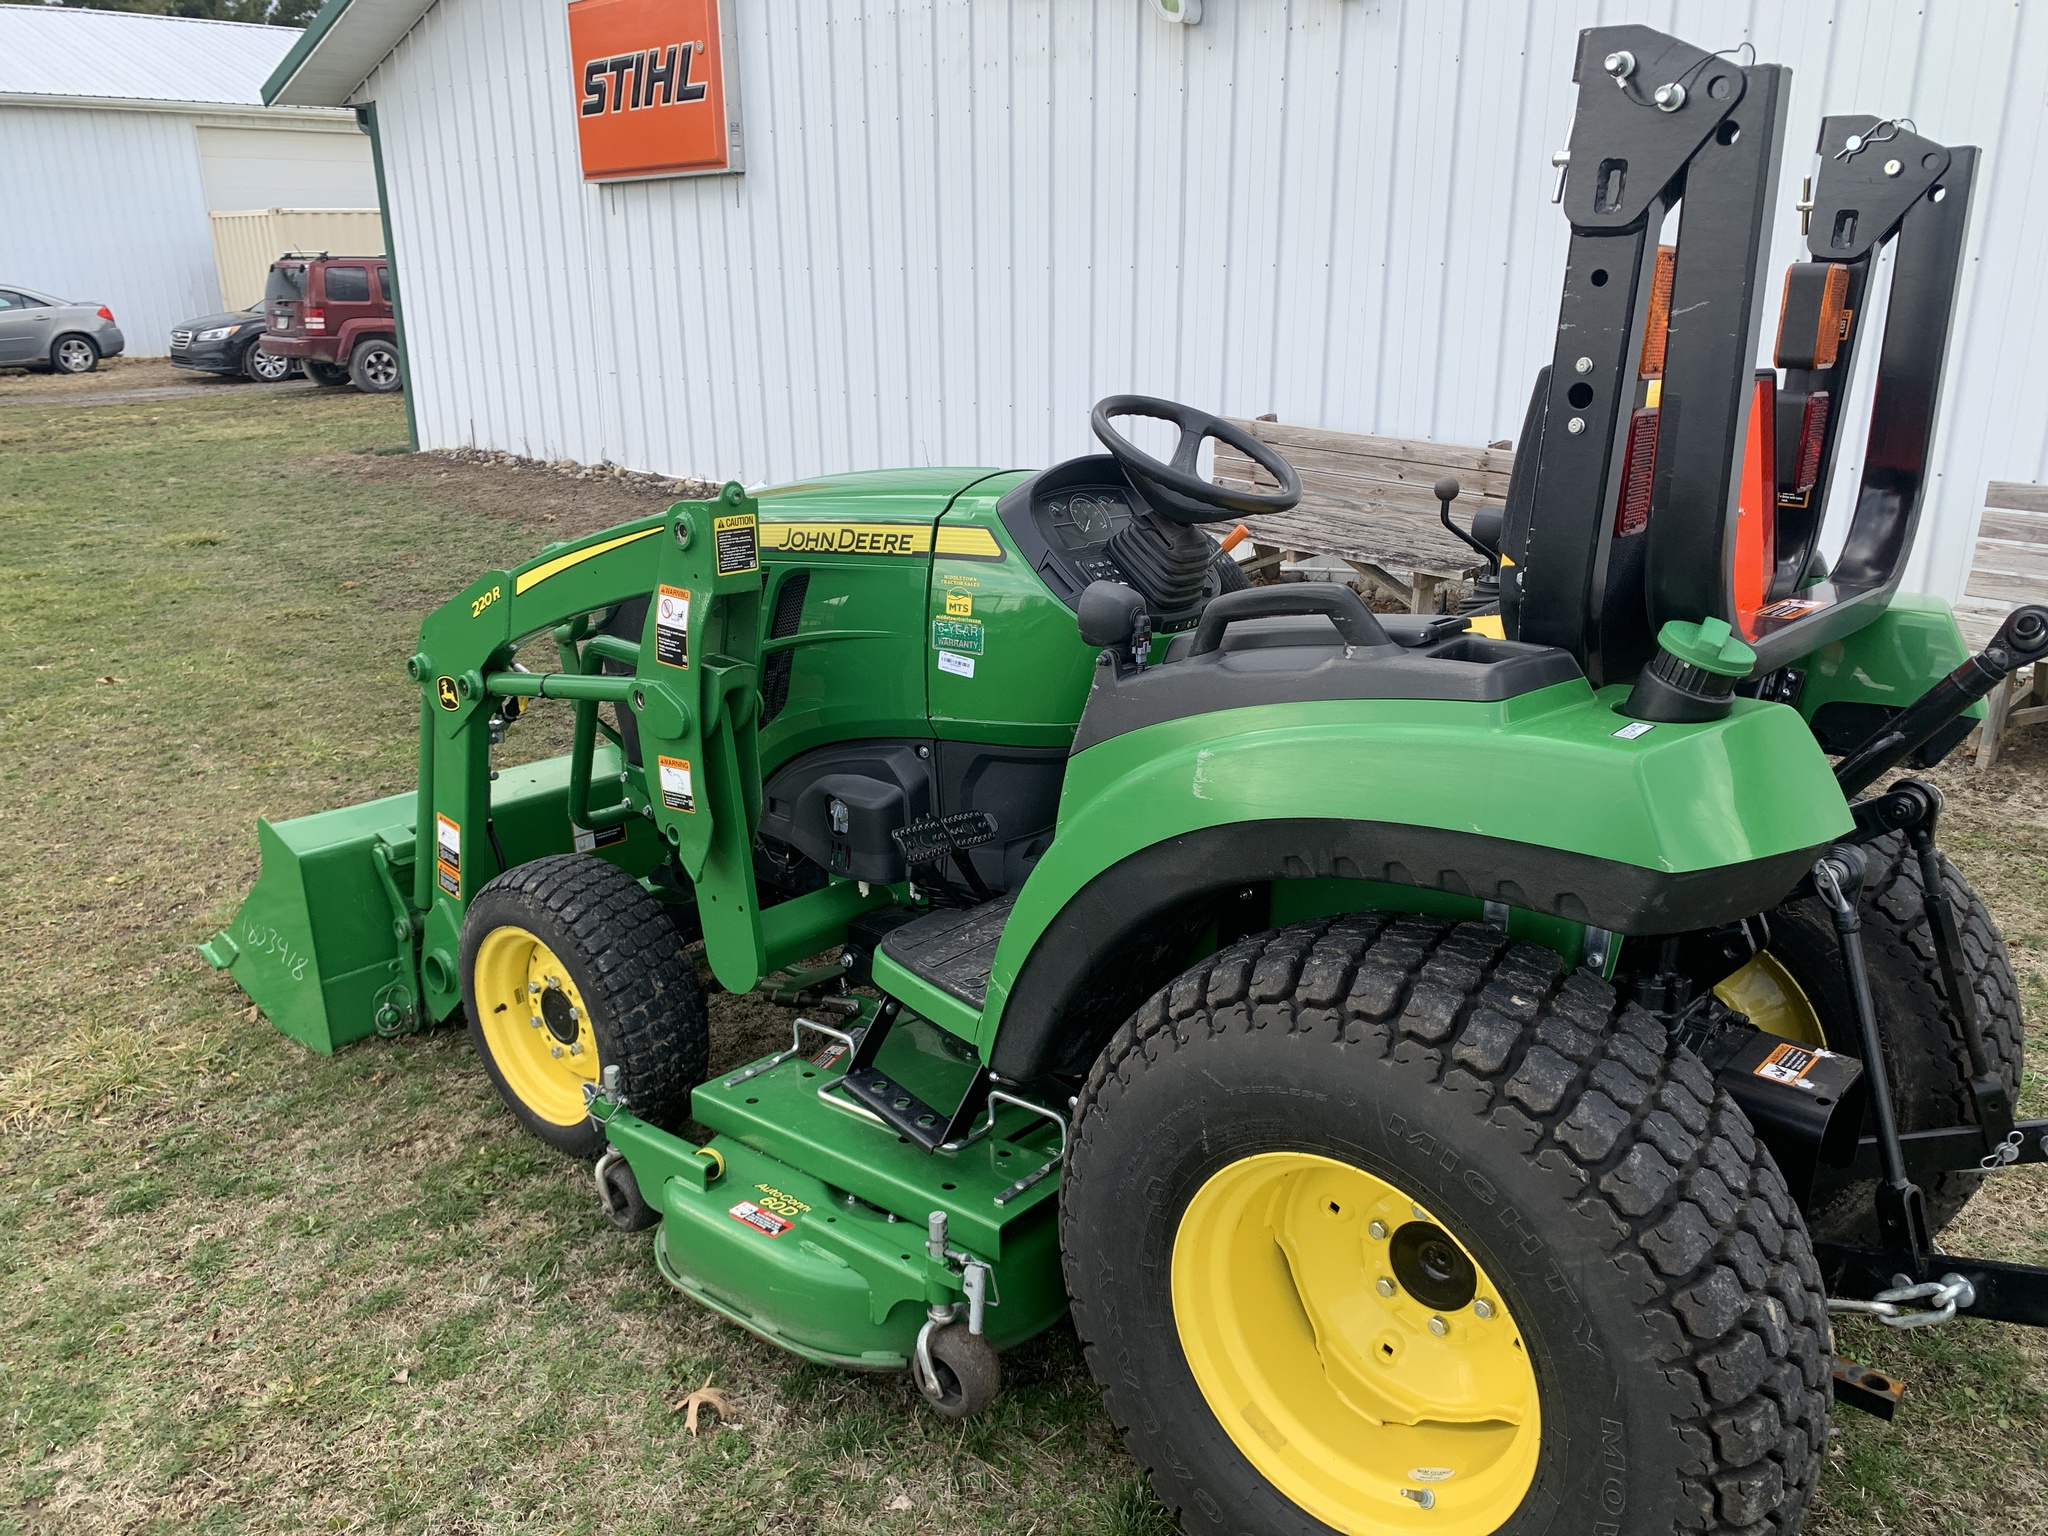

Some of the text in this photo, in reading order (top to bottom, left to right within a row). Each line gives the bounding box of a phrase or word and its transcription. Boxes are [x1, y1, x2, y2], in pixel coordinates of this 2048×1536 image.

[581, 41, 708, 118] STIHL
[725, 516, 754, 528] CAUTION
[778, 527, 836, 550] JOHN
[838, 528, 914, 552] DEERE
[665, 588, 689, 599] WARNING
[948, 602, 969, 613] MTS
[937, 637, 979, 650] WARRANTY
[759, 1197, 799, 1216] 60D
[1387, 1112, 1627, 1536] MIGHTY MO
[1098, 1250, 1224, 1524] GALAXY
